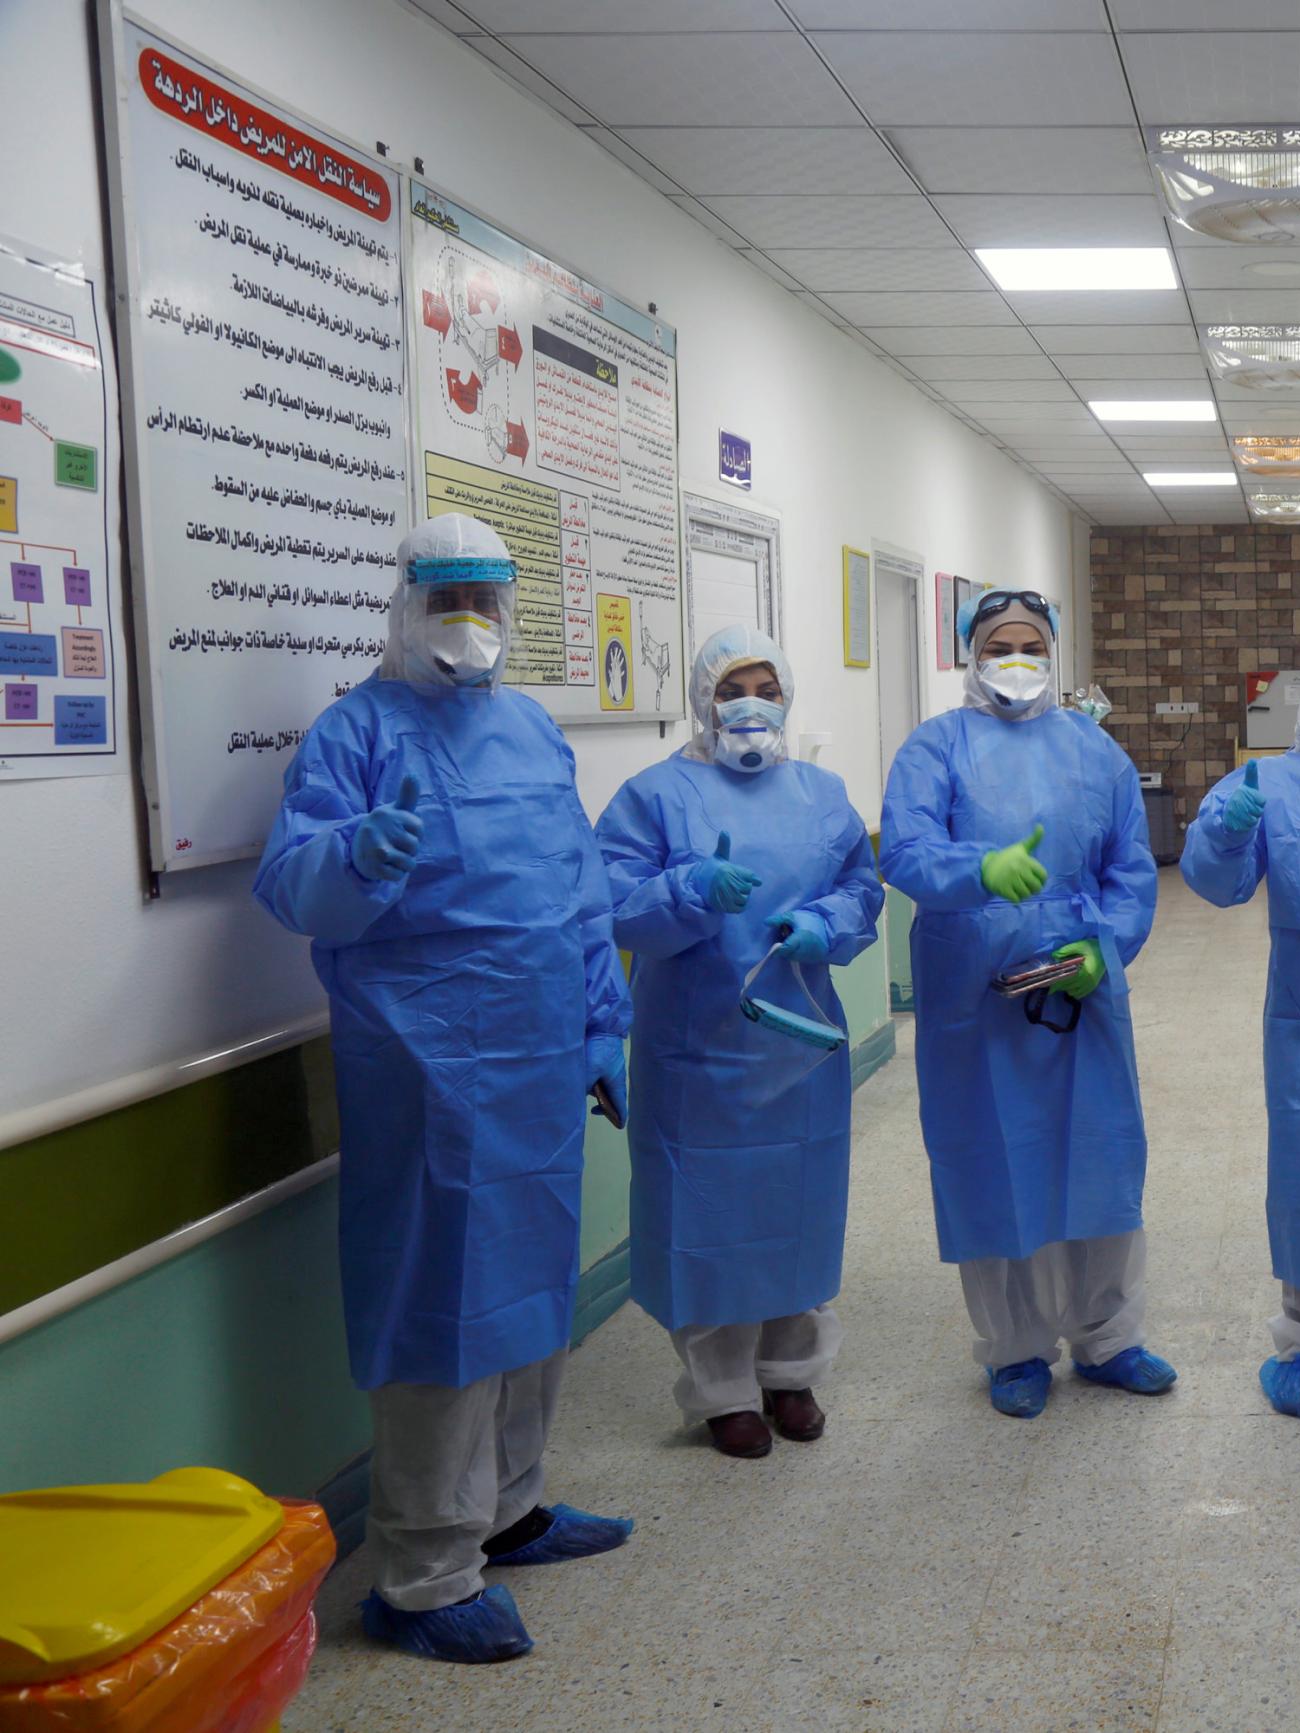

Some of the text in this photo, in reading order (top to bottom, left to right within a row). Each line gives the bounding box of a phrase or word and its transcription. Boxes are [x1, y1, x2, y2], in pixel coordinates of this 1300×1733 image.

[152, 60, 380, 208] سياسة النقل الامن للمريض داخل الردهة
[174, 147, 201, 172] النقل
[201, 163, 235, 193] واسباب
[261, 190, 279, 210] نقله
[280, 194, 304, 227] بعملية
[199, 212, 229, 239] المريض
[229, 224, 246, 245] نقل
[304, 212, 333, 238] واخباره
[333, 224, 356, 247] المريض
[246, 228, 271, 255] عملية
[271, 241, 283, 267] في
[282, 244, 315, 277] وممارسة
[316, 260, 333, 284] خبرة
[341, 272, 369, 296] ممرضين
[182, 312, 213, 335] الفولي
[305, 303, 329, 329] وفرشه
[329, 314, 353, 336] المريض
[213, 321, 223, 341] او
[223, 323, 261, 349] الكانيولا
[354, 327, 371, 343] سرير
[261, 339, 284, 360] موضع
[297, 349, 325, 370] الانتباه
[327, 362, 344, 381] يجب
[344, 365, 367, 387] المريض
[367, 371, 379, 392] رفع
[596, 358, 616, 384] ملاحظة
[379, 376, 393, 395] قبل
[266, 389, 276, 407] او
[275, 387, 303, 412] العملية
[146, 406, 177, 432] الرأس
[303, 400, 325, 420] موضع
[325, 405, 333, 423] او
[332, 409, 354, 424] الصدر
[178, 415, 210, 440] ارتطام
[211, 426, 230, 443] عدم
[264, 439, 275, 458] مع
[275, 441, 299, 462] واحده
[317, 448, 334, 469] رفعه
[334, 453, 348, 474] يتم
[347, 456, 370, 477] المريض
[370, 460, 382, 481] رفع
[382, 464, 395, 480] عند
[247, 482, 260, 503] من
[260, 486, 279, 506] عليه
[314, 499, 332, 515] جسم
[346, 498, 370, 520] العملية
[370, 507, 389, 525] موضع
[388, 510, 395, 527] او
[185, 521, 396, 569] عند وضعه على السرير يتم تغطية المريض واكمال الملاحظات
[211, 579, 238, 600] العلاج
[239, 581, 247, 602] او
[247, 583, 266, 602] الدم
[266, 583, 291, 608] قناني
[290, 587, 299, 606] او
[301, 586, 329, 607] السوائل
[329, 590, 351, 606] اعطاء
[351, 589, 364, 610] مثل
[168, 627, 200, 651] المريض
[200, 629, 216, 653] لمنع
[216, 630, 243, 652] جوانب
[244, 629, 260, 648] ذات
[260, 630, 285, 649] خاصة
[307, 636, 316, 654] او
[314, 635, 340, 655] متحرك
[340, 636, 364, 657] بكرسي
[227, 731, 250, 753] النقل
[250, 730, 274, 753] عملية
[274, 730, 293, 751] خلال
